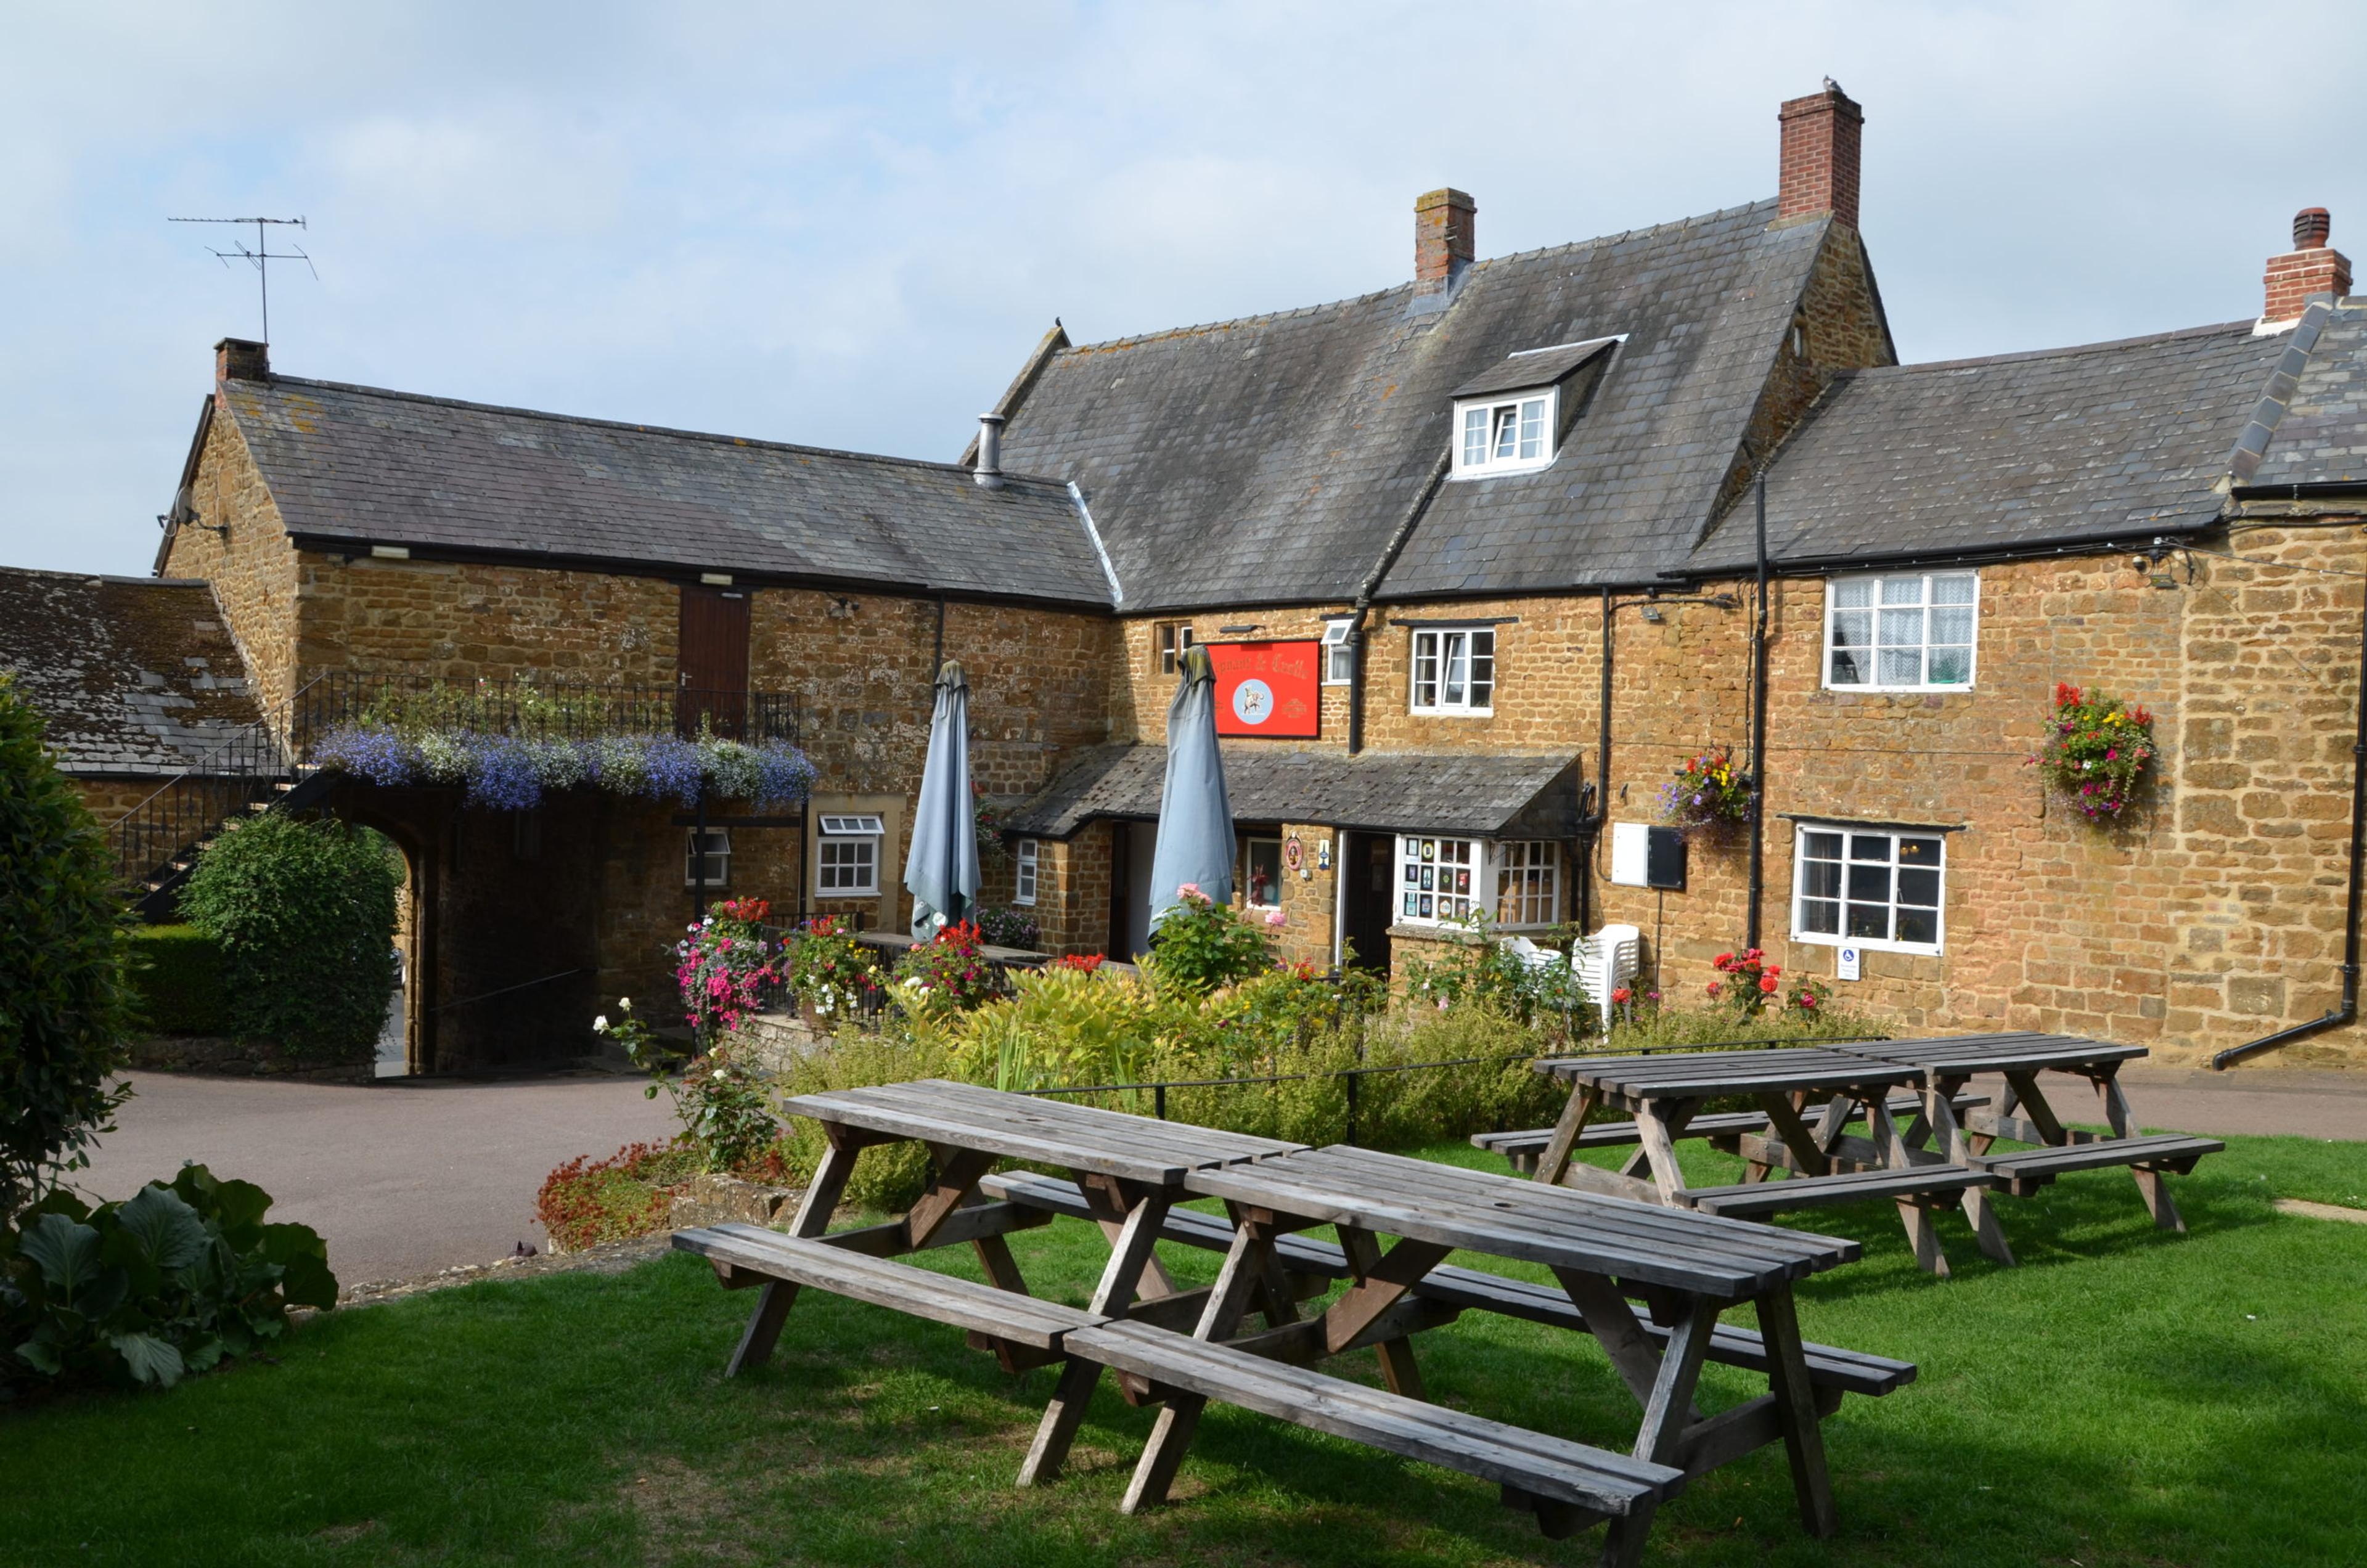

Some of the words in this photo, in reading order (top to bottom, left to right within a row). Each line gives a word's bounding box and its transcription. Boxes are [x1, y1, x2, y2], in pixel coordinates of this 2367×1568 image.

[1215, 655, 1251, 674] phant
[1254, 653, 1266, 671] &
[1272, 653, 1310, 679] Castle
